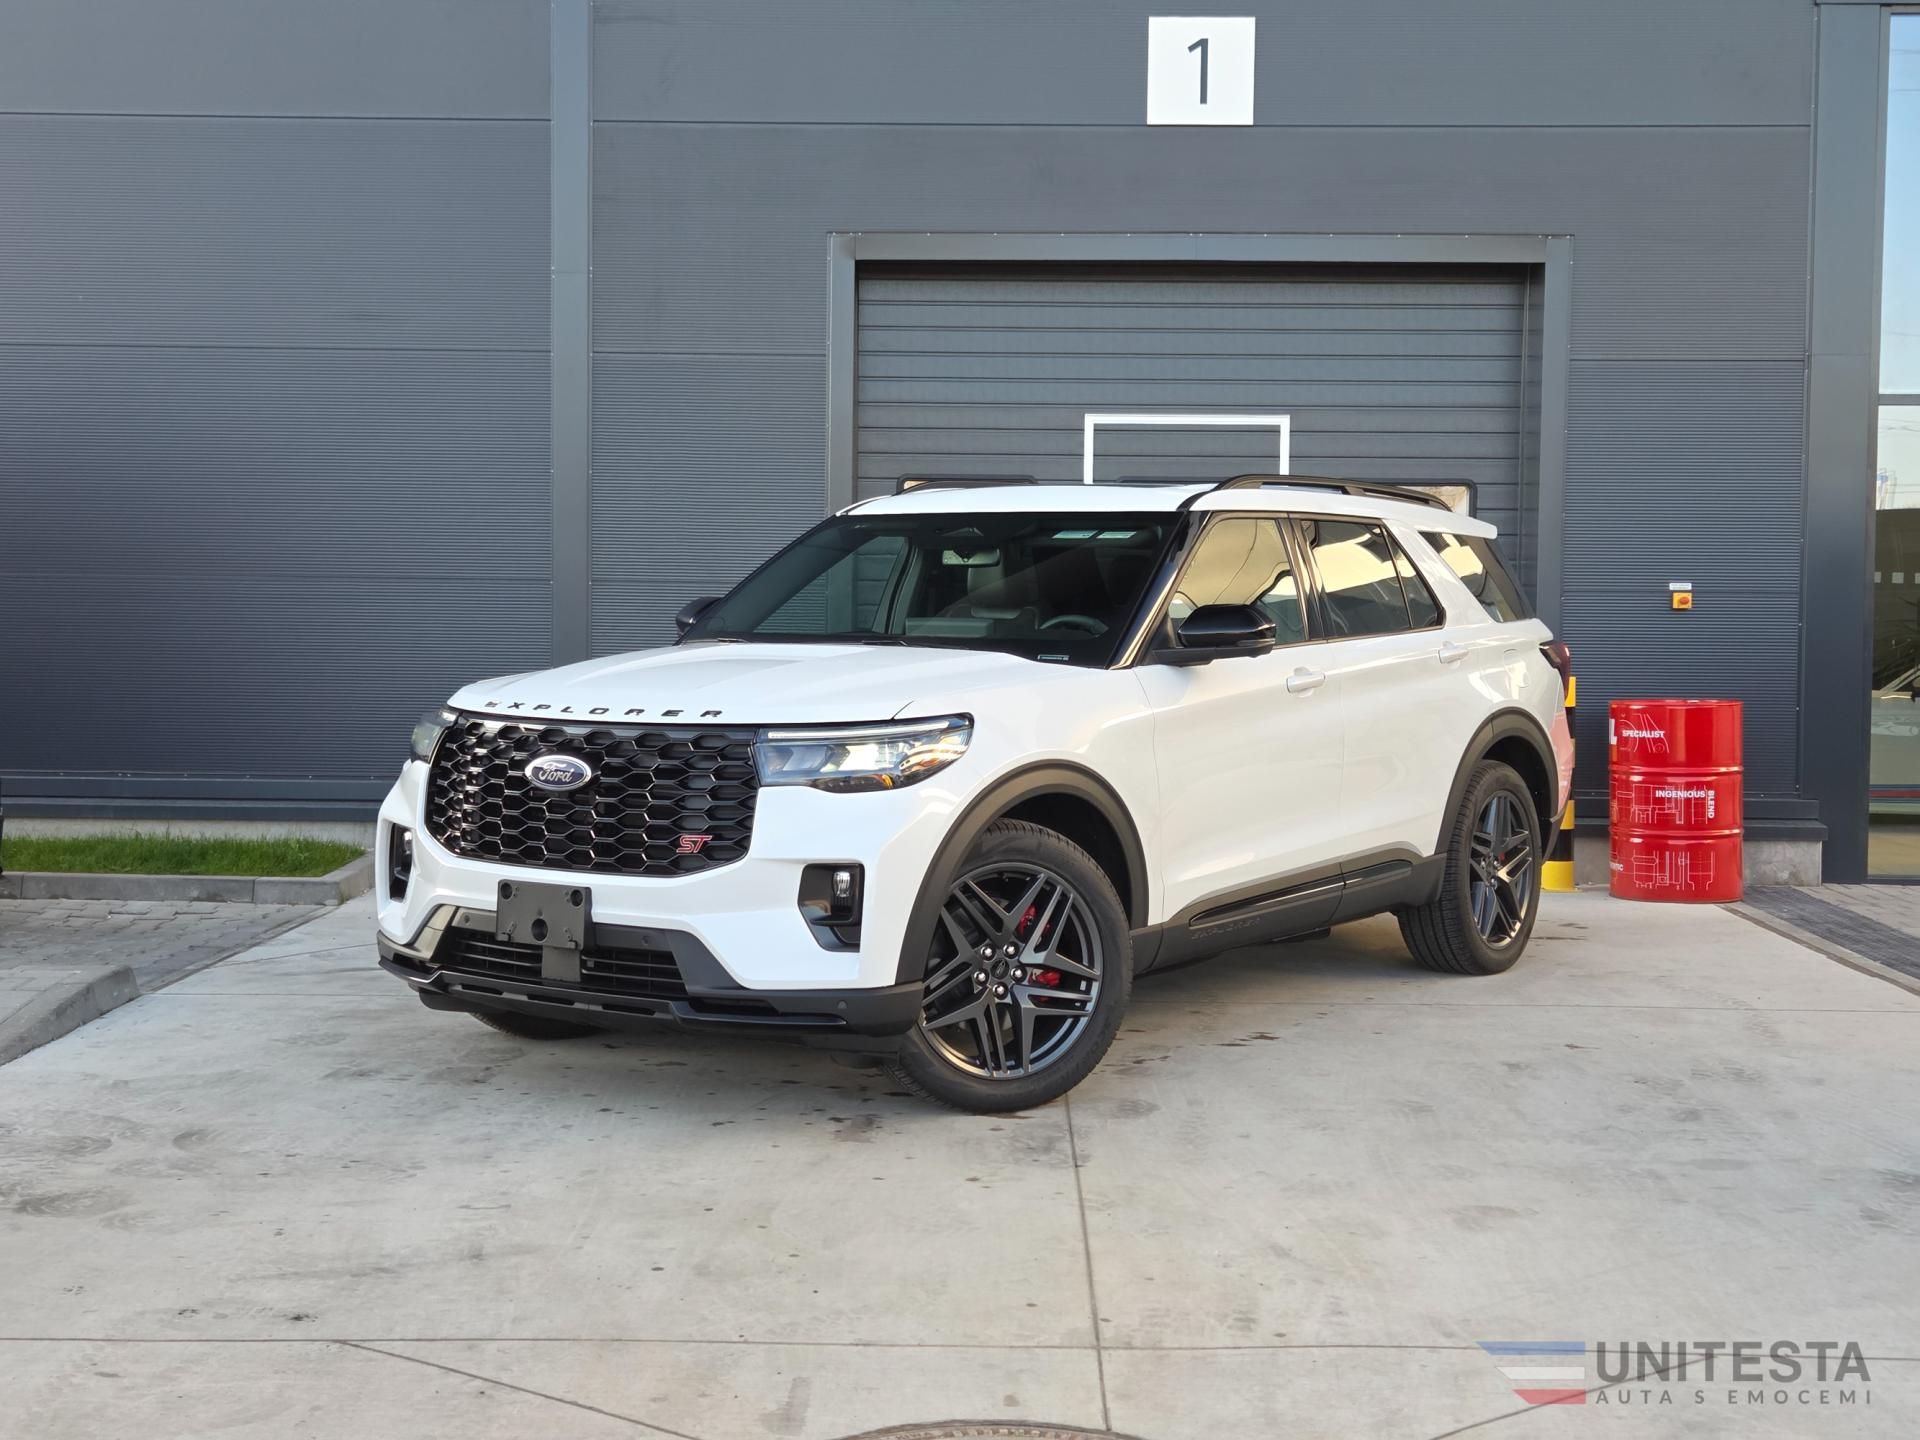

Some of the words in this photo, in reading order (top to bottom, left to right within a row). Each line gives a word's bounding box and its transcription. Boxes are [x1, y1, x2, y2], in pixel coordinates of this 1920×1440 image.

[1188, 38, 1208, 104] 1
[485, 701, 722, 718] EXPLORER
[1622, 729, 1665, 738] SPECIALIST
[538, 762, 573, 783] Ford
[1655, 790, 1706, 798] INGENIOUS
[677, 835, 712, 853] ST
